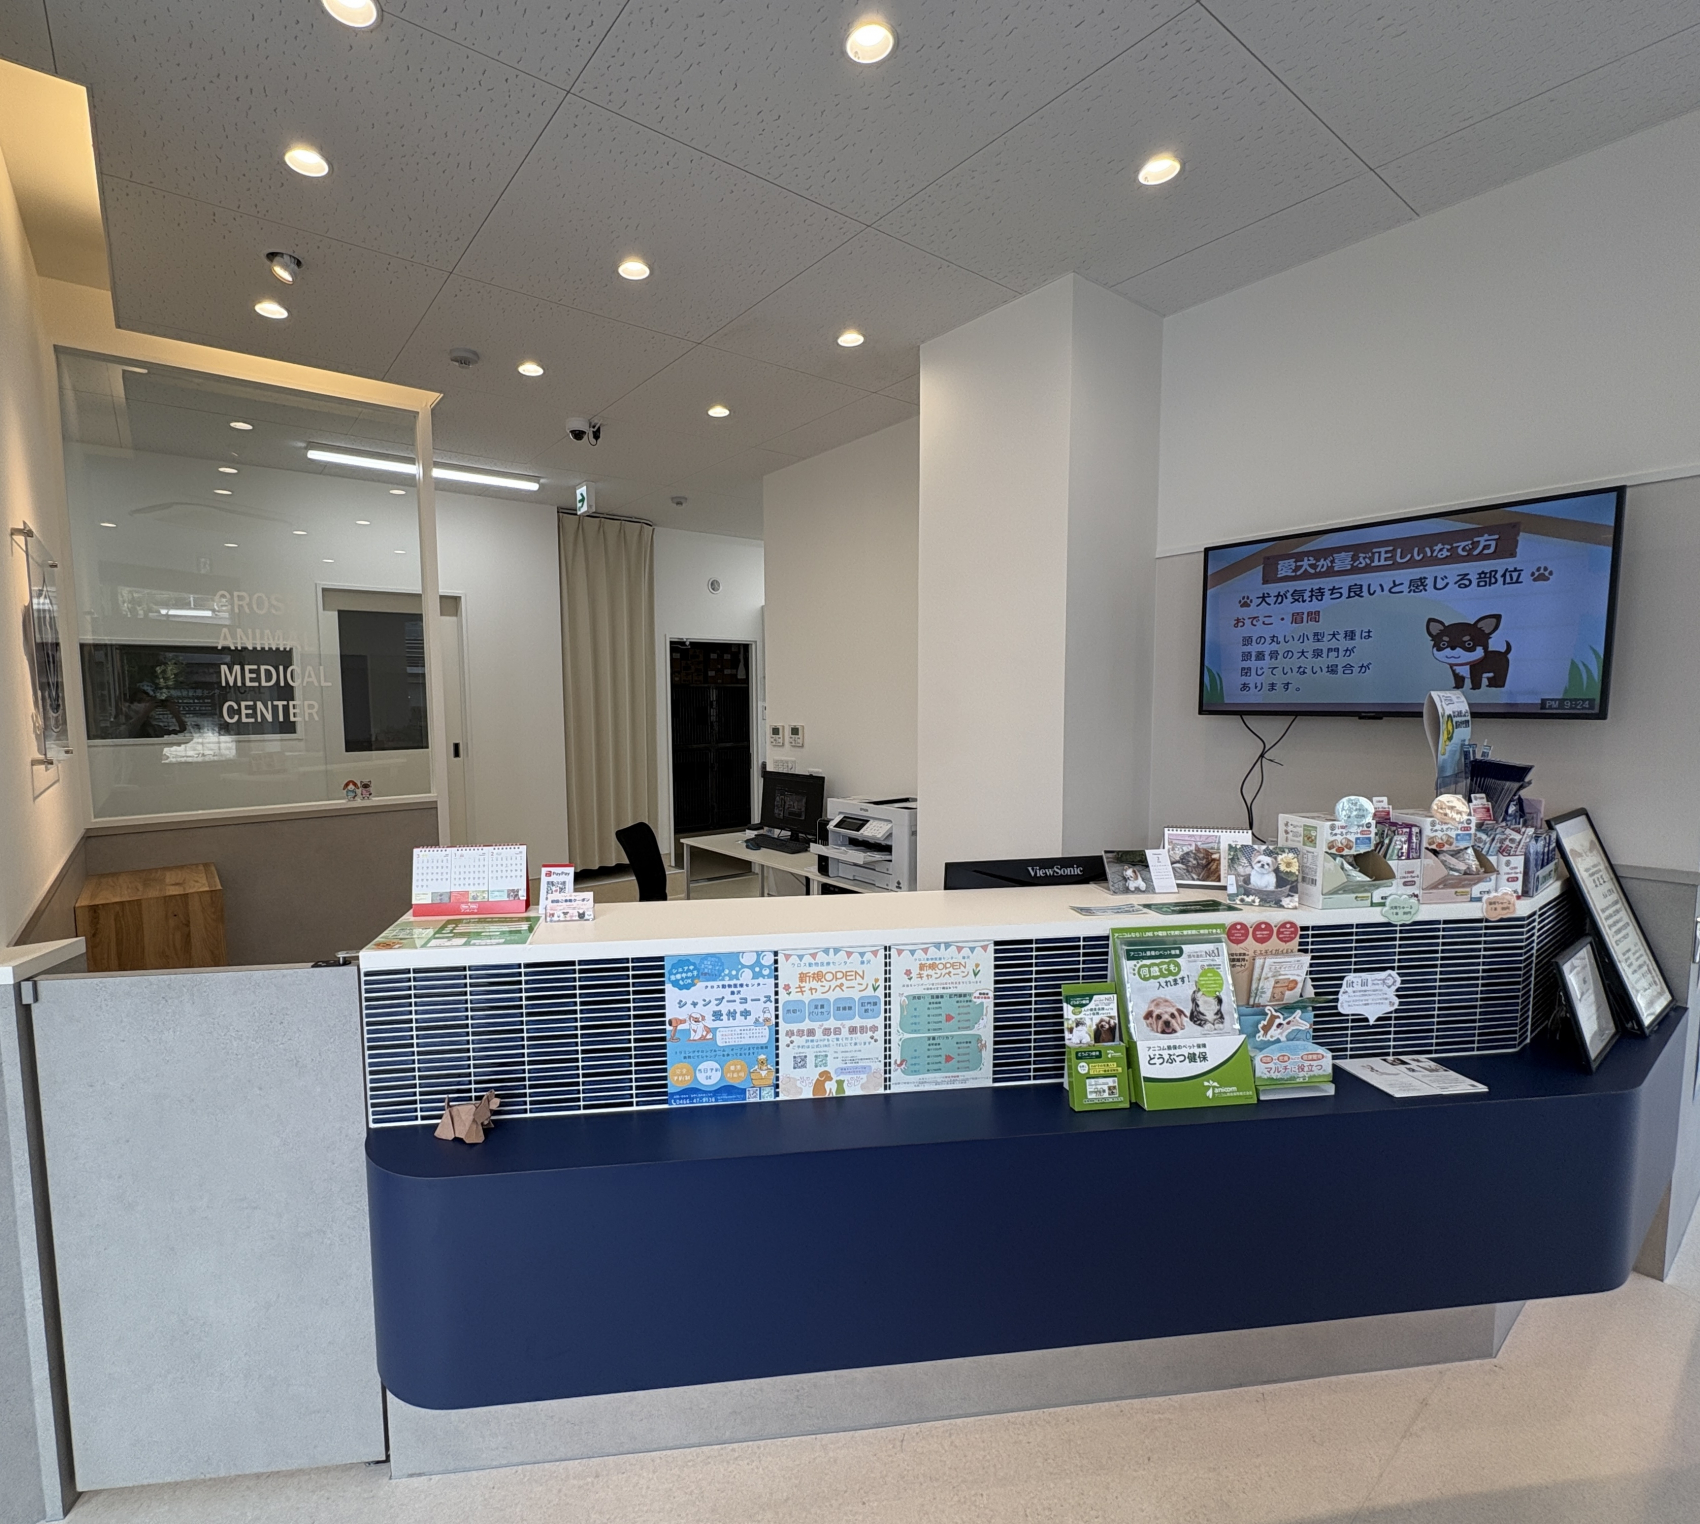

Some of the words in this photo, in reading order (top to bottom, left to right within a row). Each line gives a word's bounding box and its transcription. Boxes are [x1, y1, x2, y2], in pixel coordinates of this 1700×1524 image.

[1276, 533, 1500, 578] 愛犬が喜ぶ正しいなで方
[1255, 567, 1525, 608] 犬が気持ち良いと感じる部位
[213, 590, 298, 616] CROS
[1233, 610, 1321, 629] おでこ・眉間
[1241, 628, 1374, 647] 頭の丸い小型犬種は
[1240, 645, 1357, 663] 頭蓋骨の大泉門が
[220, 664, 333, 687] MEDICAL
[1240, 661, 1373, 678] 閉じていない場合が
[1239, 681, 1301, 693] あります。
[222, 700, 319, 723] CENTER
[1545, 700, 1559, 709] PM
[1564, 700, 1590, 709] 9:24
[1027, 864, 1084, 877] ViewSonic
[791, 960, 854, 968] クロス動物医療センター
[918, 961, 967, 972] 新規OPEN
[1140, 962, 1178, 978] 何歳でも
[798, 969, 865, 984] 新規OPEN
[916, 970, 969, 980] キャンペーン
[795, 982, 869, 996] キャンペーン
[677, 995, 773, 1008] シャンプーコース
[711, 1008, 752, 1021] 受付中
[1147, 1051, 1209, 1066] どうぶつ健保
[1264, 1063, 1323, 1074] マルチに役立つ
